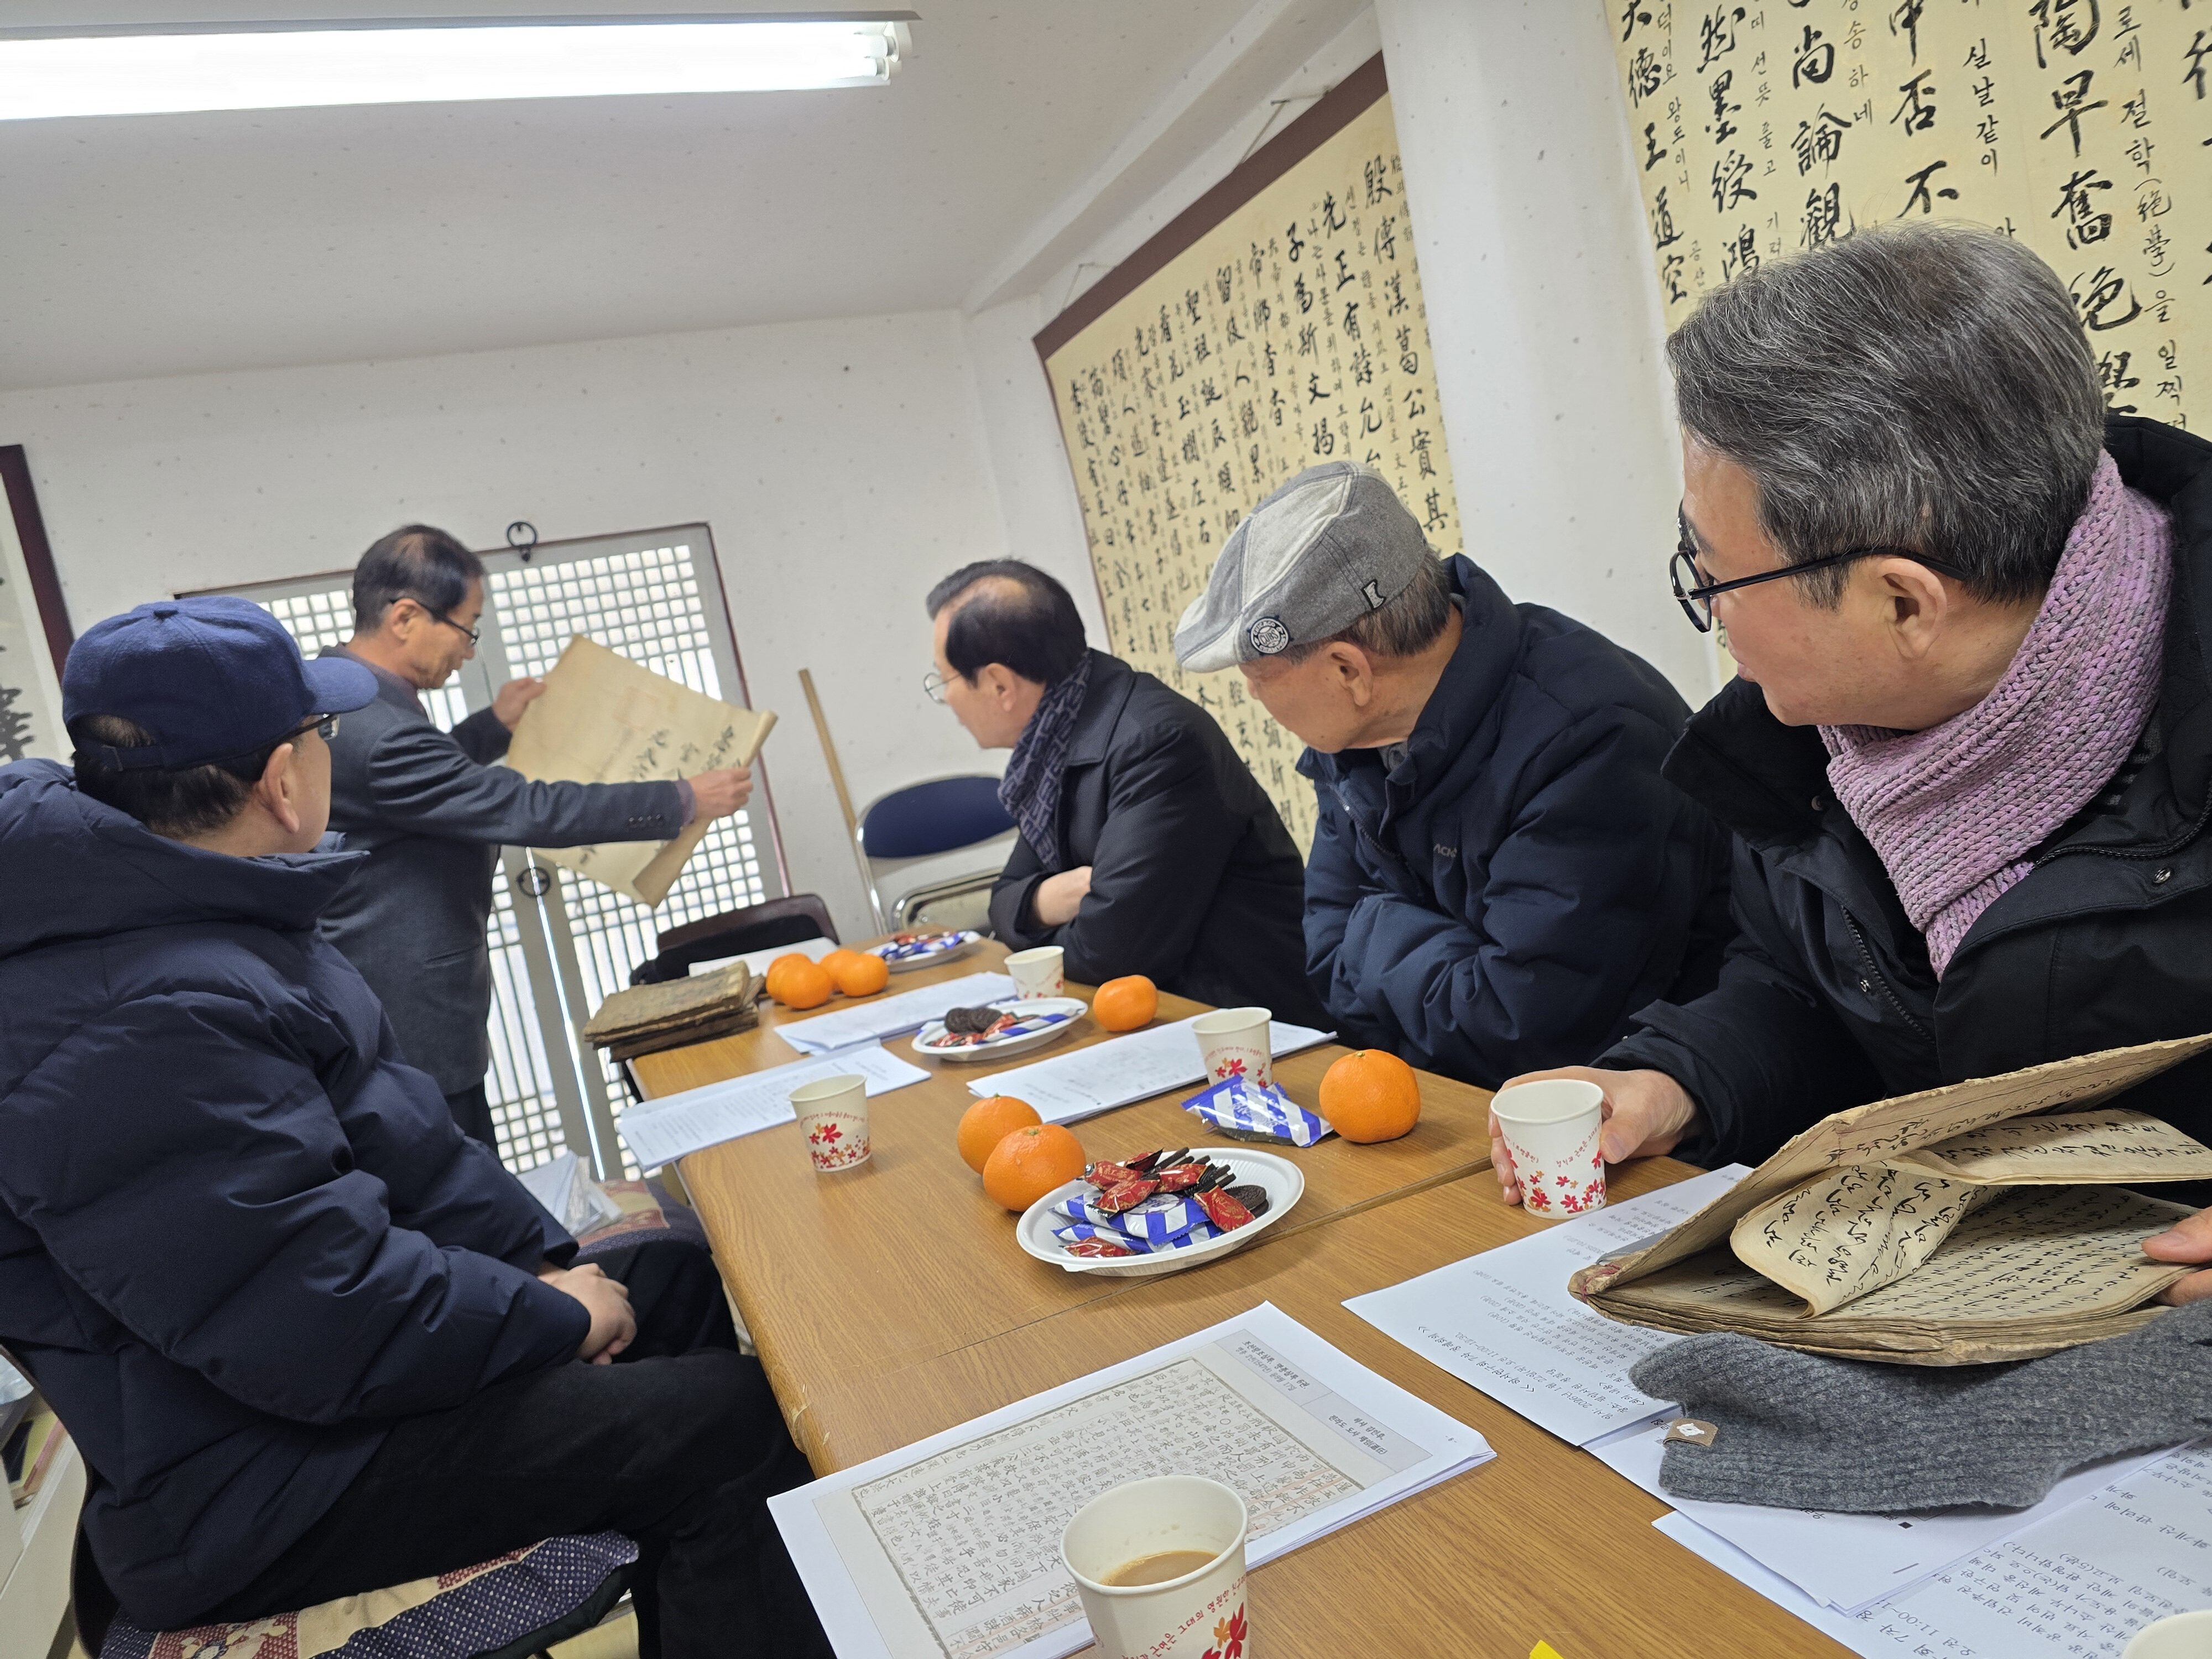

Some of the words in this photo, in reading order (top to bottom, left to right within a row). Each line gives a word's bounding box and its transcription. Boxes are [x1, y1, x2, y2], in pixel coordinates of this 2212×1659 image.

[2104, 1501, 2154, 1525] 관리에
[2002, 1541, 2081, 1582] 환영합니다.)
[2058, 1552, 2125, 1585] 보고(5분)
[1960, 1569, 2001, 1593] 연구한
[2002, 1574, 2046, 1598] 재선충
[2085, 1582, 2118, 1600] 제안
[1956, 1585, 2013, 1616] 건립추진
[2049, 1597, 2096, 1622] 소나무
[2074, 1592, 2119, 1616] 용도가
[2026, 1604, 2056, 1622] 번역
[1149, 1631, 1177, 1658] 근면은
[1177, 1609, 1204, 1635] 그대의
[2017, 1616, 2063, 1642] 공적비
[2064, 1620, 2095, 1641] 자료
[1942, 1637, 1976, 1656] 오전
